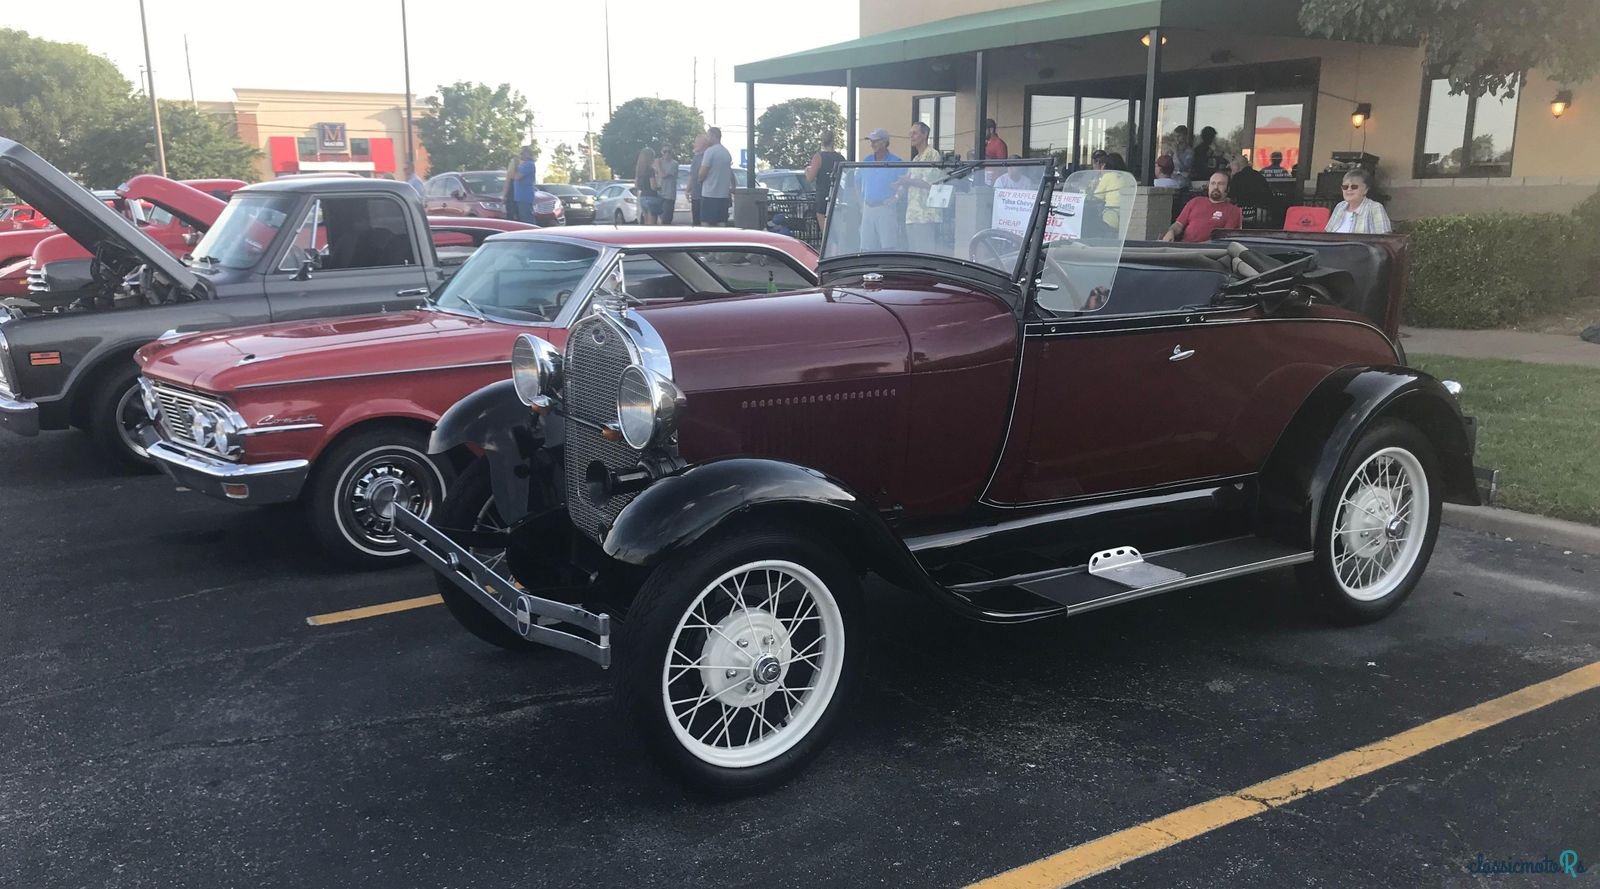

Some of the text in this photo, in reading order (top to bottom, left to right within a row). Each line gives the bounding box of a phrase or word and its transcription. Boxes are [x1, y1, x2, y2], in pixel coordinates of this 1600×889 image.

[324, 125, 343, 141] M
[1012, 192, 1037, 200] RAFFLE
[1016, 199, 1034, 208] Chevy
